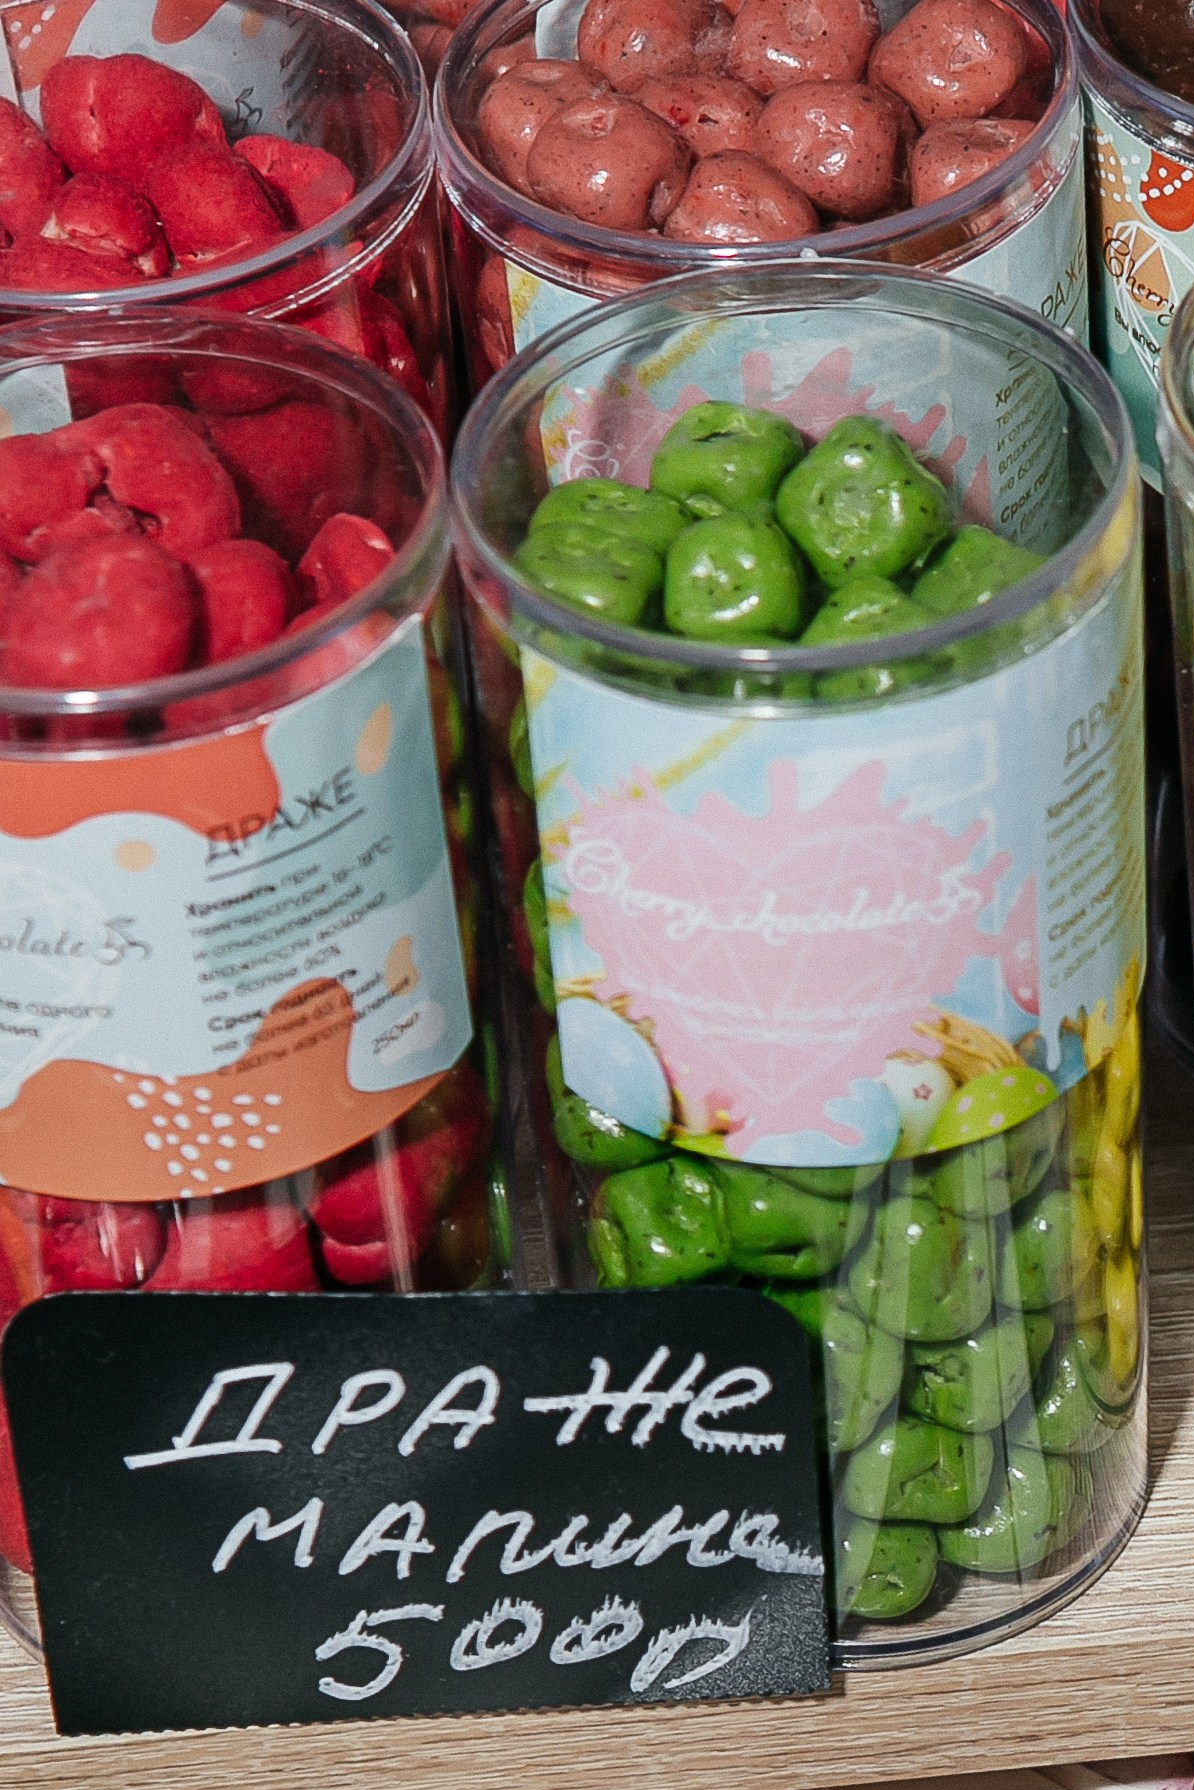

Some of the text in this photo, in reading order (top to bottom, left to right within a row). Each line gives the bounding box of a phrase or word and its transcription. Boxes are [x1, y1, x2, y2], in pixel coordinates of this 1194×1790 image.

[1041, 235, 1083, 321] РАЖЕ
[1001, 487, 1032, 523] Срок
[205, 766, 356, 866] ДРАЖЕ
